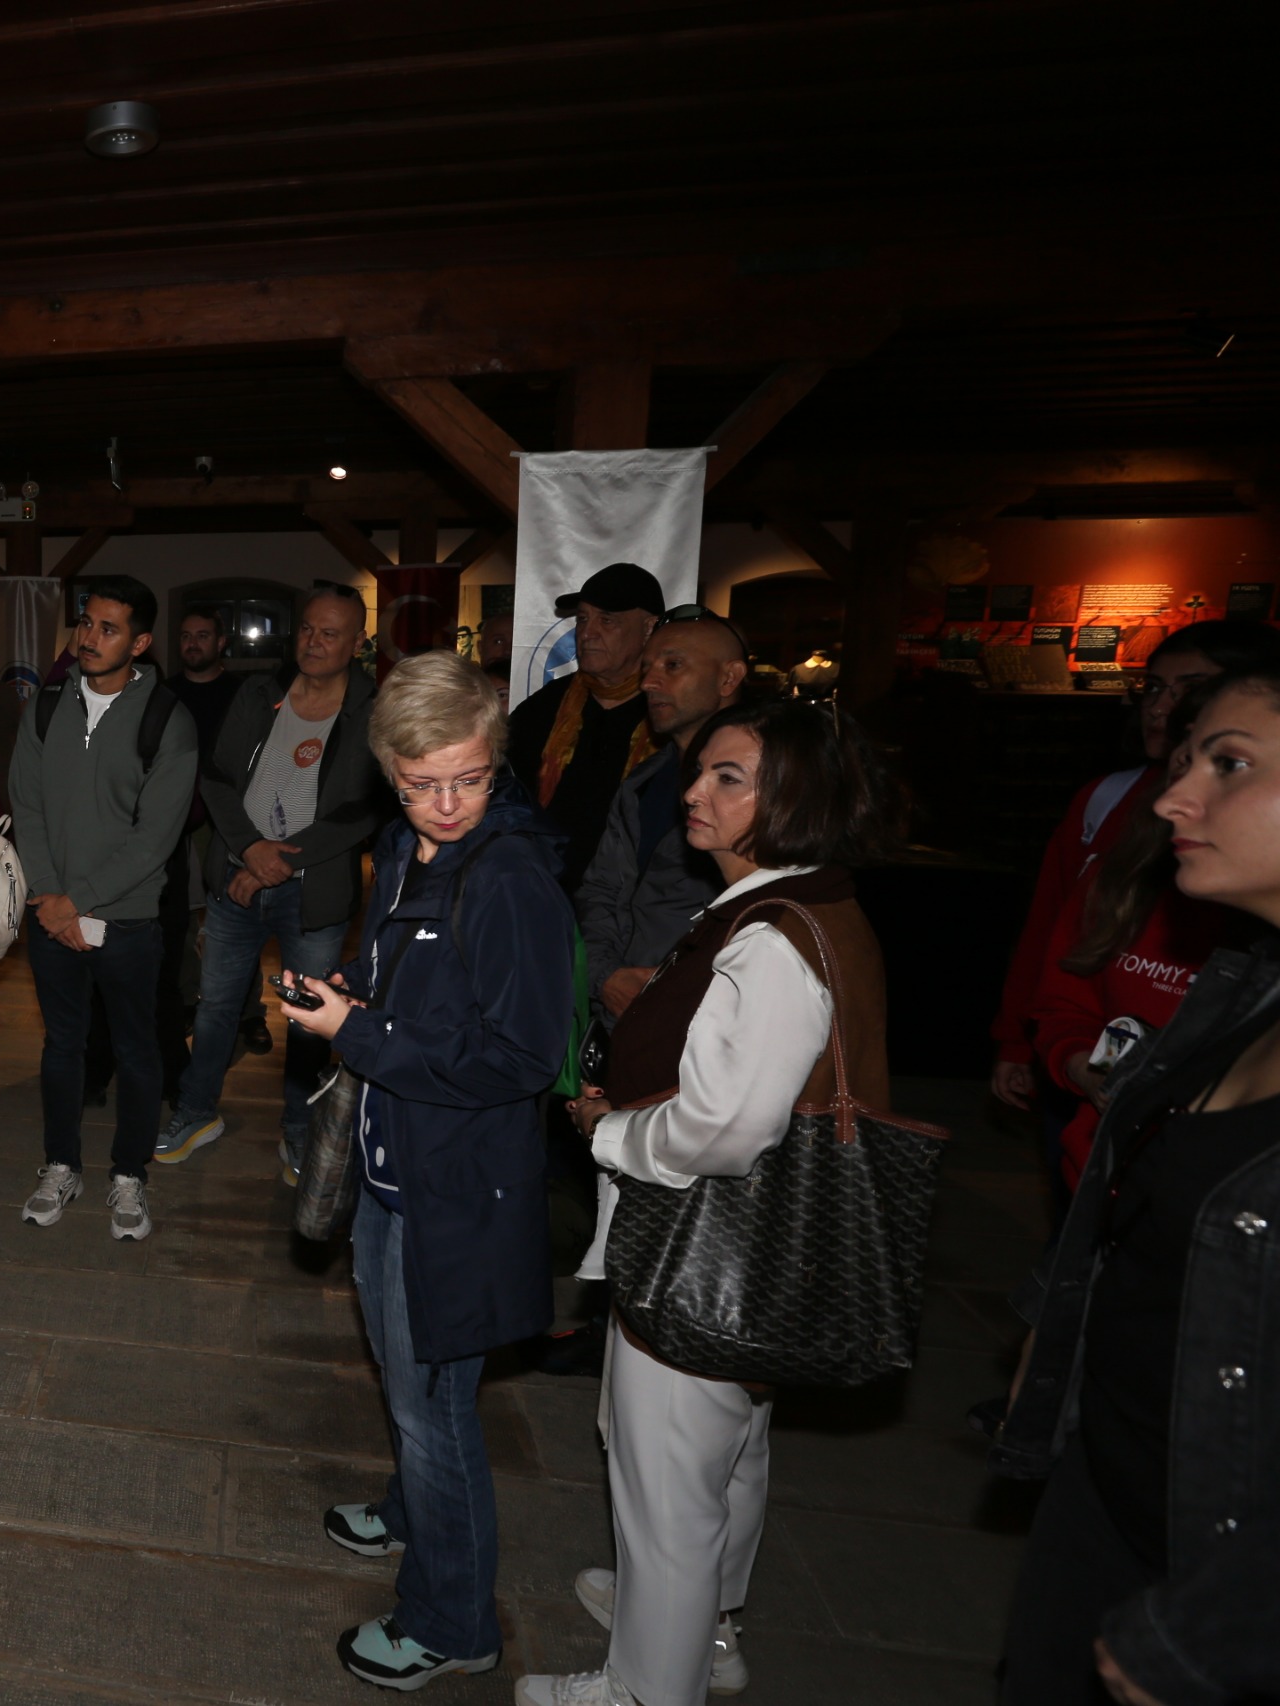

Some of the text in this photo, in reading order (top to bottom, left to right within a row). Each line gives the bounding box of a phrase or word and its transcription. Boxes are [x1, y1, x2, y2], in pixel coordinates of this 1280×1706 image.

[1115, 952, 1187, 984] TOMMY
[1152, 981, 1188, 996] THREE CLA
